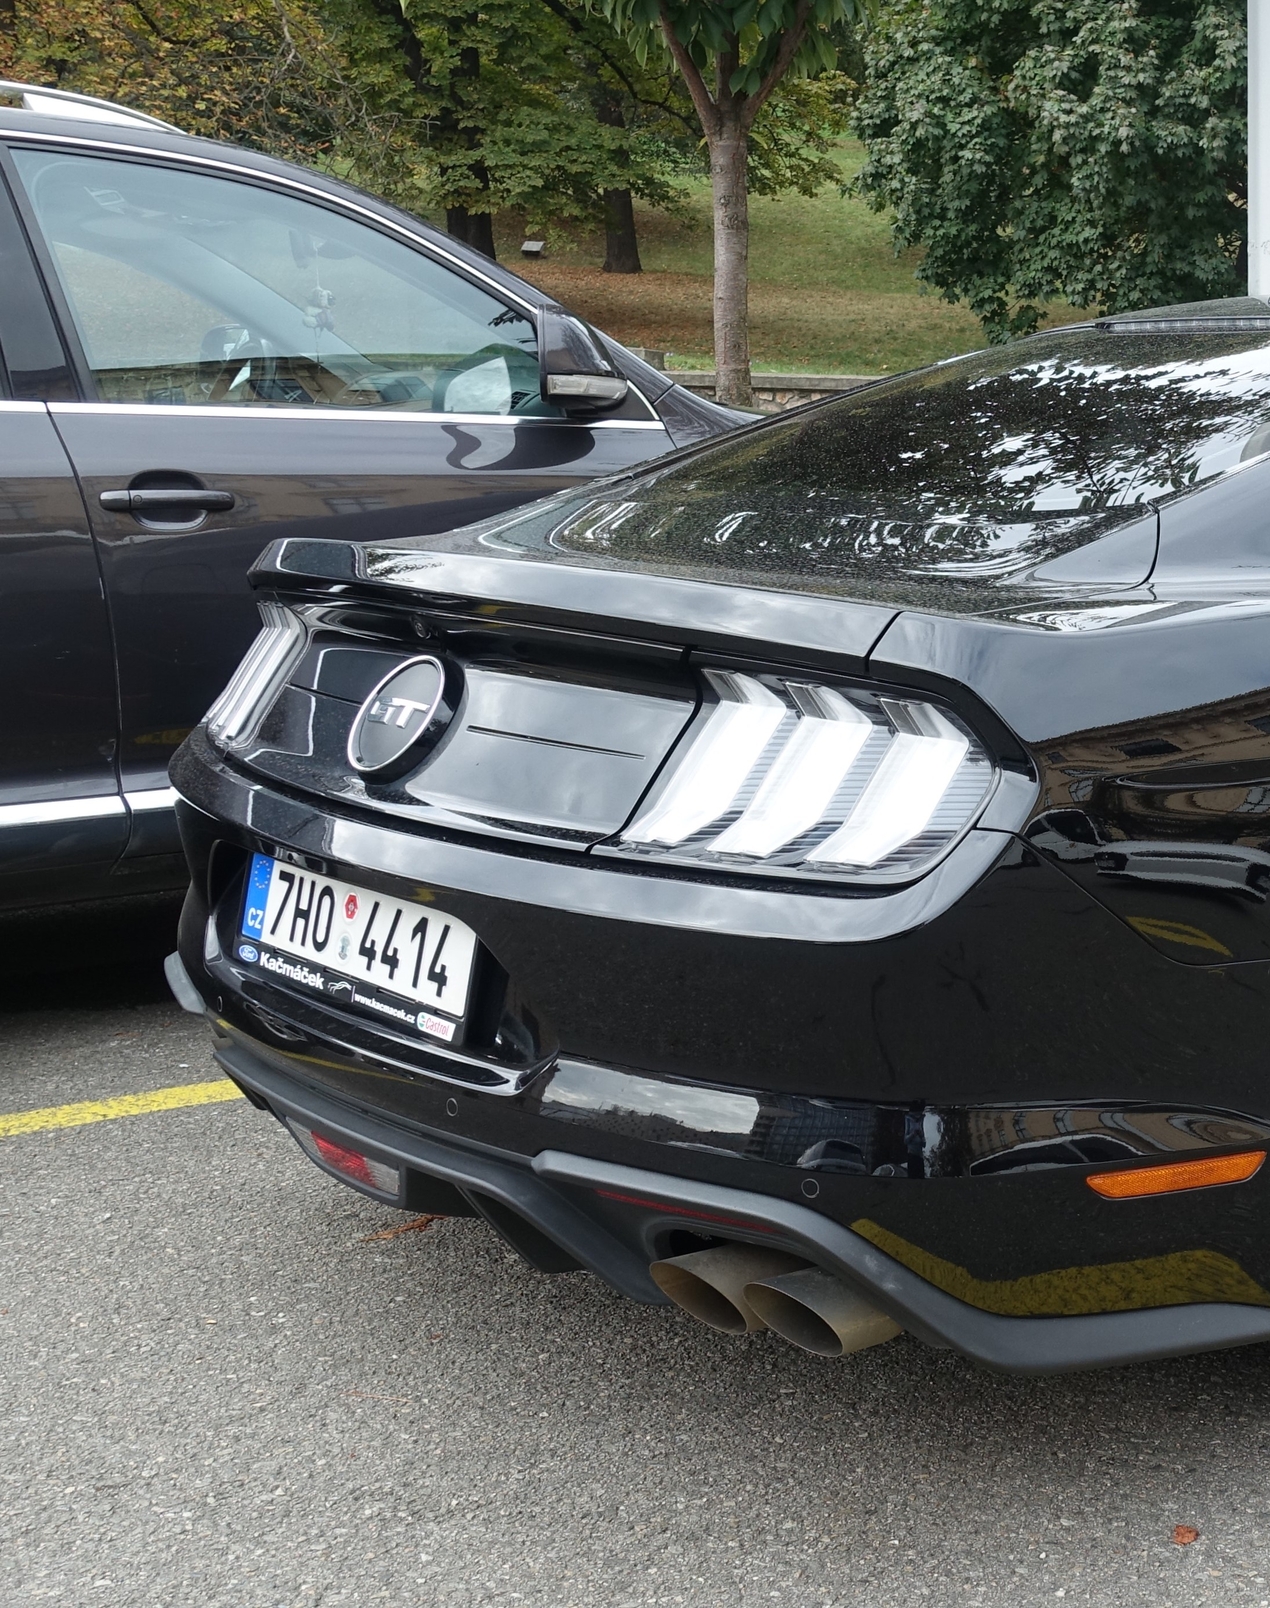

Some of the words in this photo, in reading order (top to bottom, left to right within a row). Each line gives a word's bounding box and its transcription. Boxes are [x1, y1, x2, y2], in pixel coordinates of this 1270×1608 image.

[368, 697, 430, 729] GT
[247, 906, 262, 929] CZ
[358, 900, 451, 998] 4414
[260, 952, 324, 990] Kačmáček
[354, 993, 415, 1024] www.kacmacek.cz
[425, 1017, 450, 1036] Castrol
